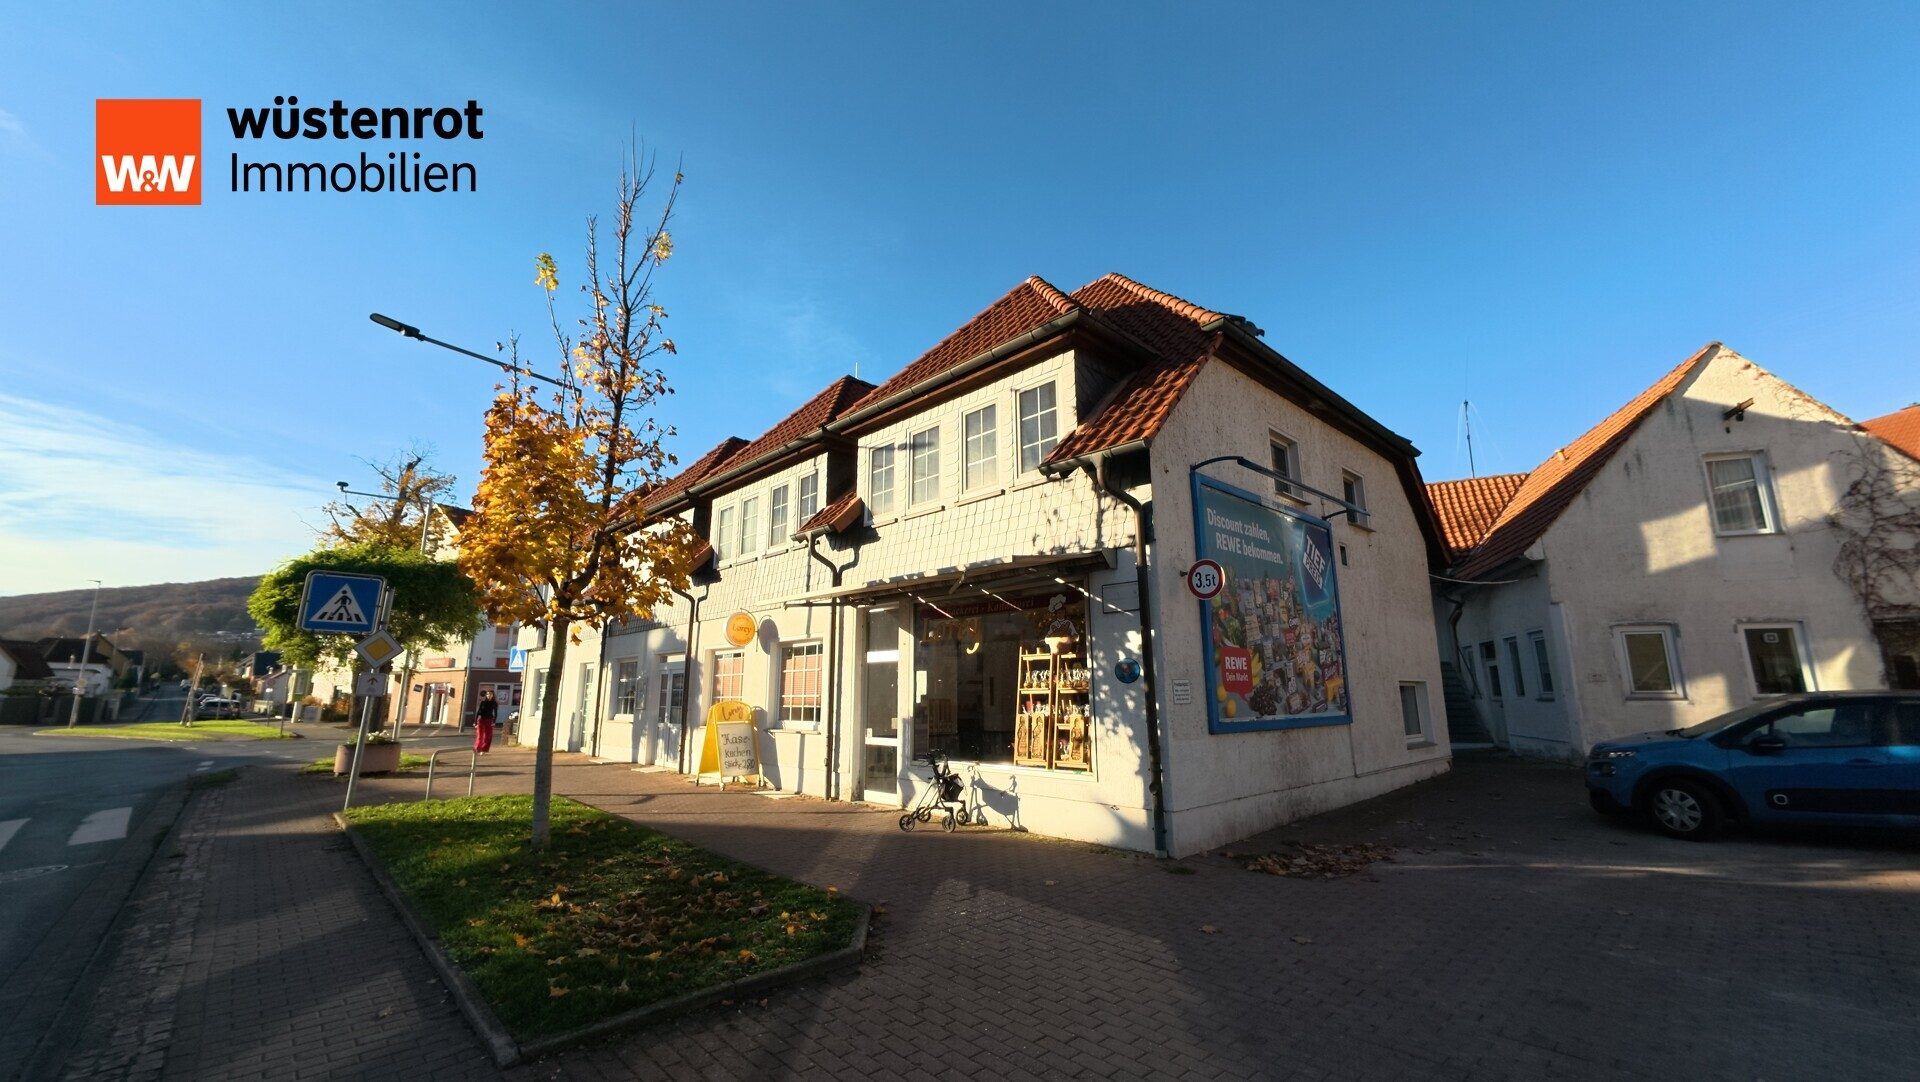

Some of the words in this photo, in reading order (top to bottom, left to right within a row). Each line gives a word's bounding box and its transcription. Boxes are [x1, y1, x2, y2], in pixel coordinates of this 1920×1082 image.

[1206, 508, 1243, 534] Discount
[1244, 522, 1270, 543] zahlen,
[1216, 533, 1242, 555] REWE
[1242, 540, 1284, 565] bekommen.
[1306, 534, 1326, 573] TIEF
[1225, 657, 1248, 670] REWE
